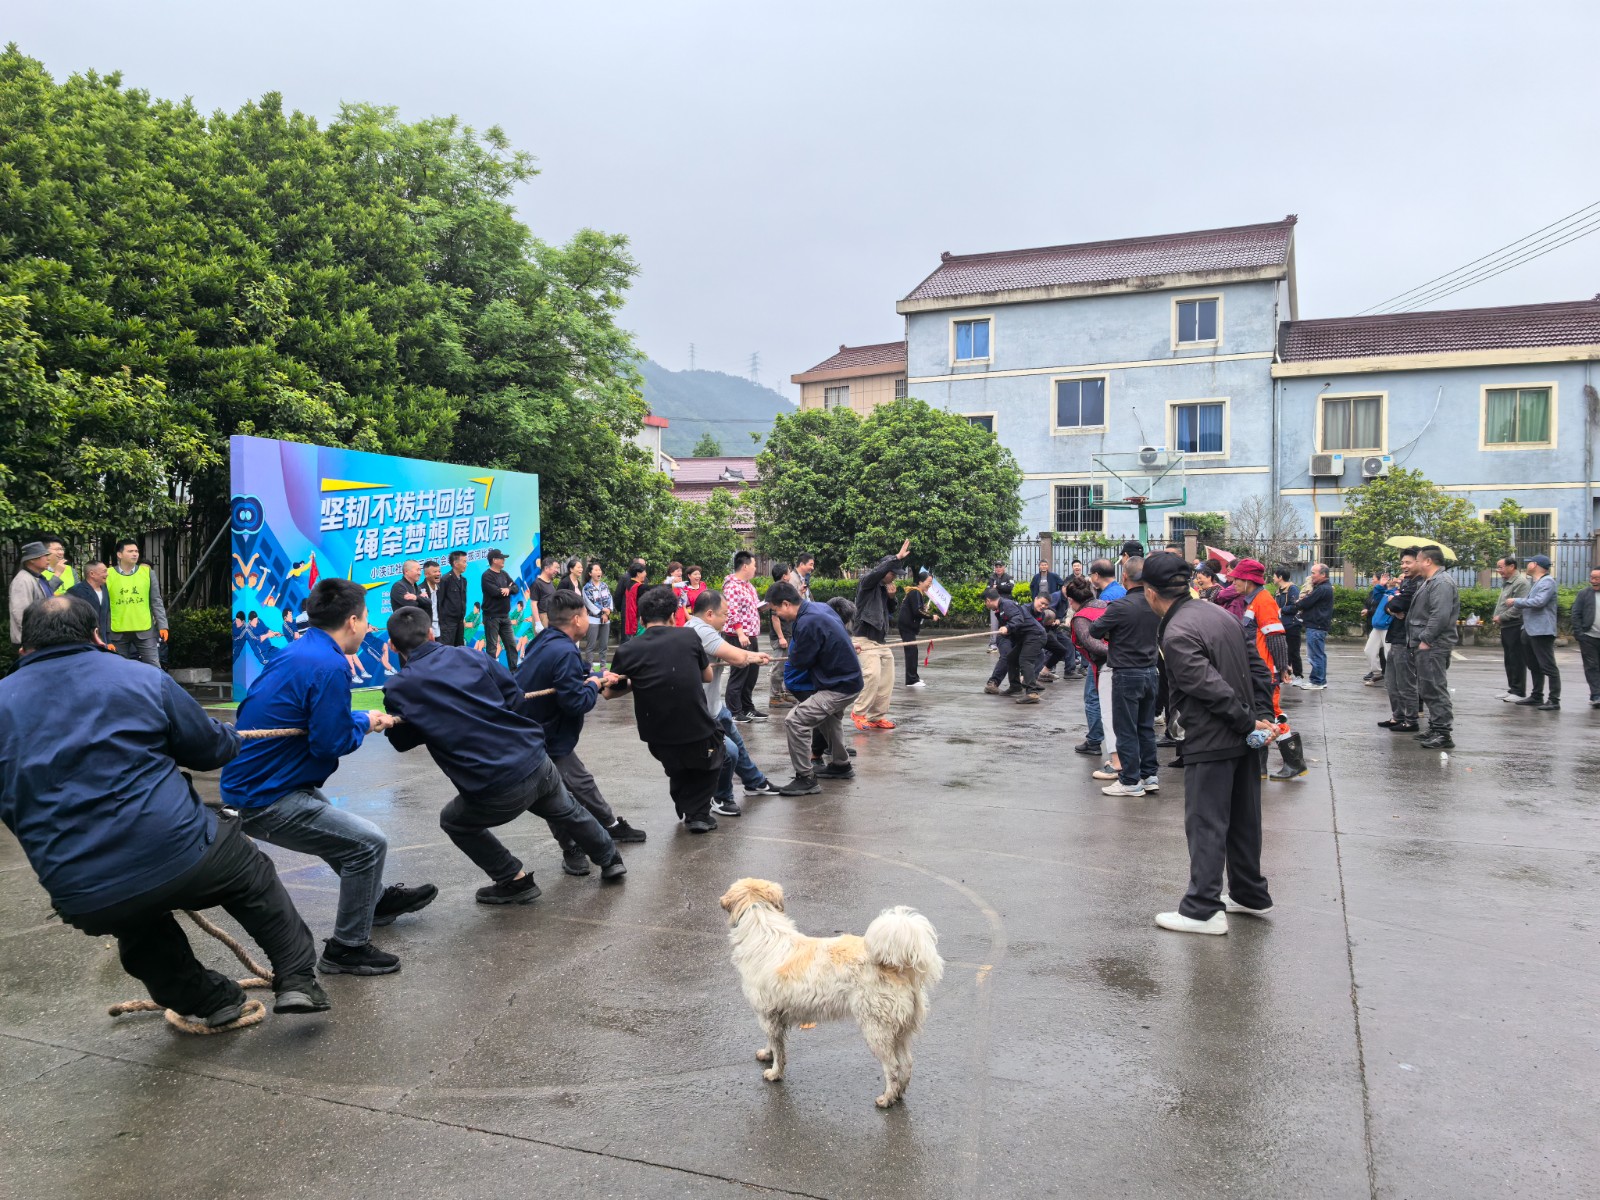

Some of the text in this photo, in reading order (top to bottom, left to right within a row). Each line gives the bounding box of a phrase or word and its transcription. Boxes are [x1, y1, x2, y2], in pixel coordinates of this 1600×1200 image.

[319, 487, 476, 532] 坚韧不拔共团结
[354, 512, 511, 561] 绳牵梦想展风采
